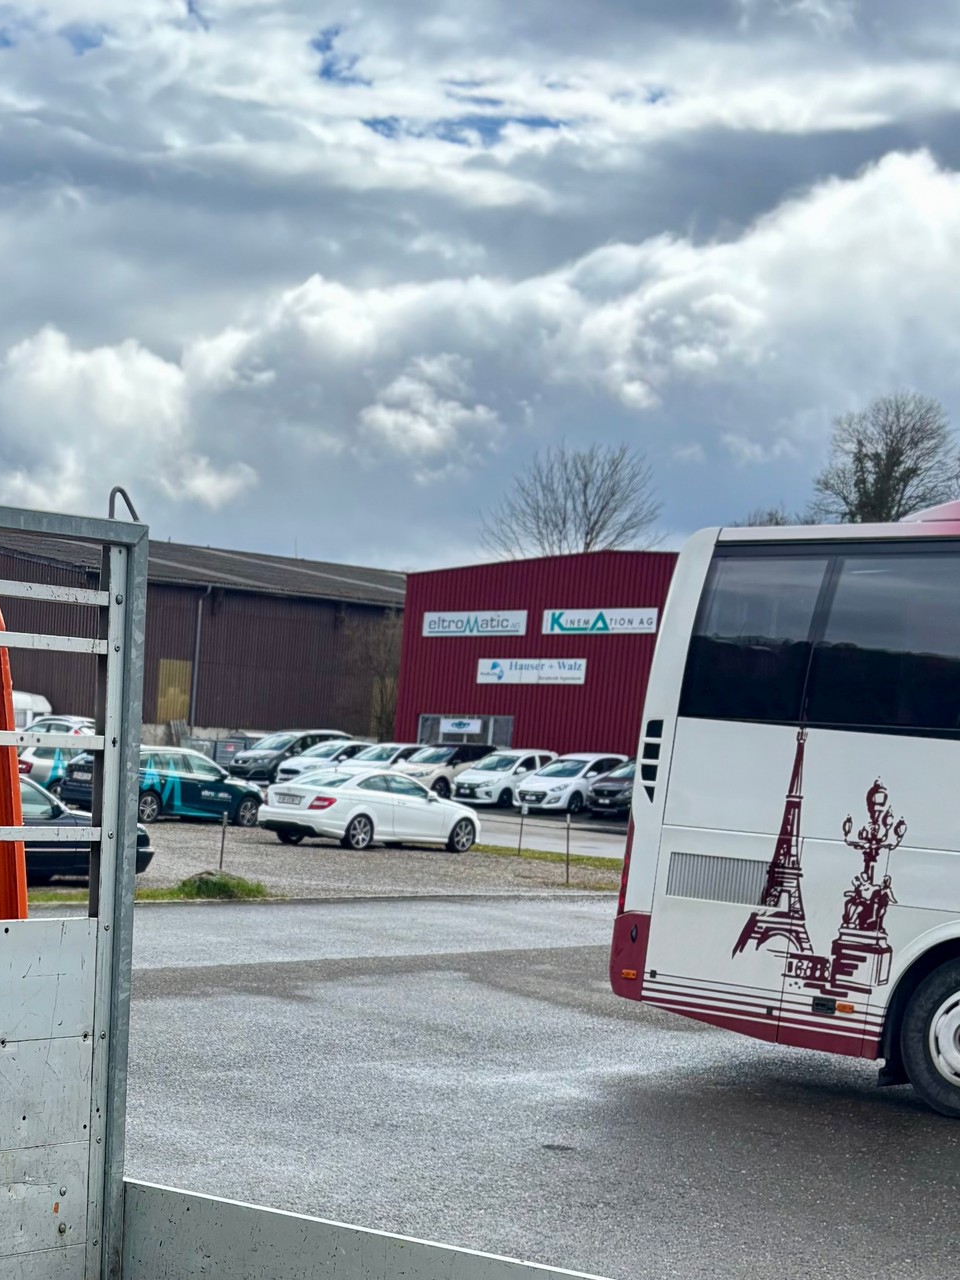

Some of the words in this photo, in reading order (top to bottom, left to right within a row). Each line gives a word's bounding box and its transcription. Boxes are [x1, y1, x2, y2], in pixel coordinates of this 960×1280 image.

[638, 617, 654, 626] AG
[509, 661, 546, 671] Hauser
[557, 661, 582, 671] Walz
